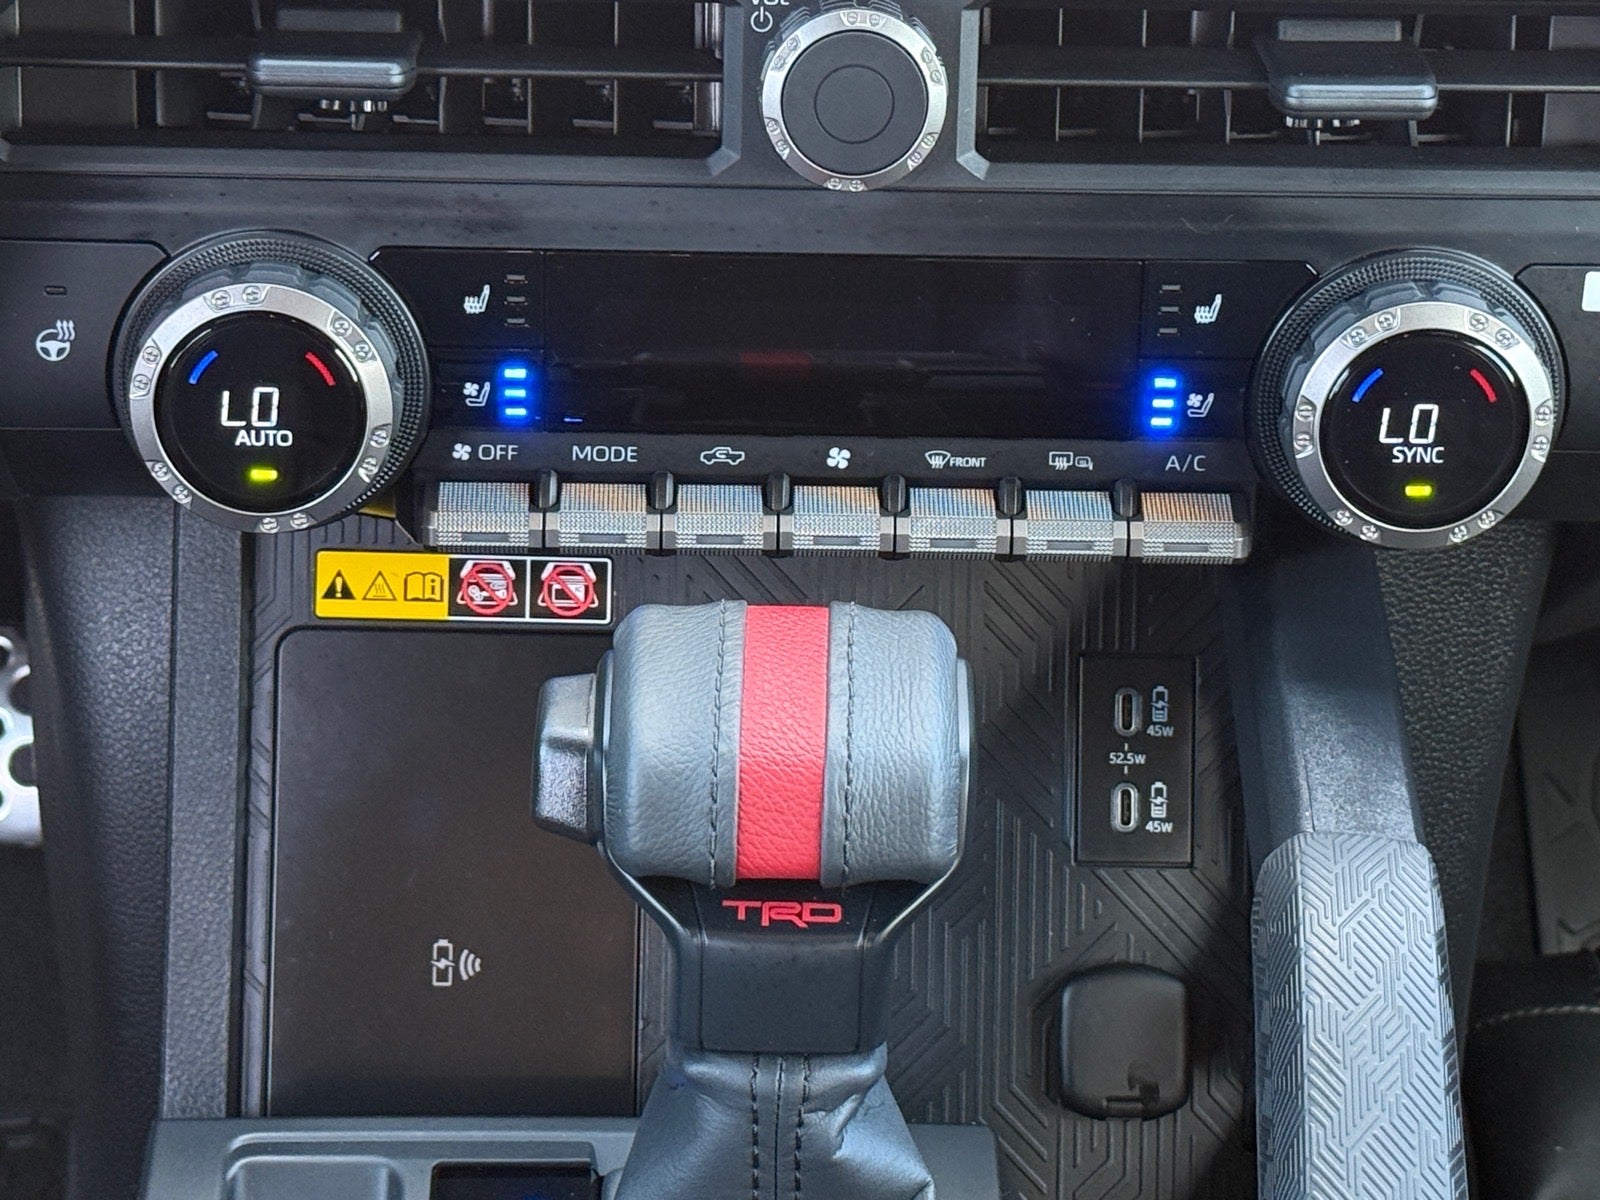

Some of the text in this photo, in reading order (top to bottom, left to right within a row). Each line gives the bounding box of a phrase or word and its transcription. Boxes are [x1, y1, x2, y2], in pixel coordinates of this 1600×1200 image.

[234, 429, 293, 448] AUTO
[478, 444, 519, 461] OFF
[571, 445, 638, 463] MODE
[1391, 446, 1445, 463] SYNC
[949, 456, 987, 468] FRONT
[1164, 454, 1207, 473] A/C
[1146, 724, 1174, 737] 45W
[1109, 752, 1146, 765] 52.5W
[1144, 821, 1173, 834] 45W
[722, 899, 842, 928] TRD
